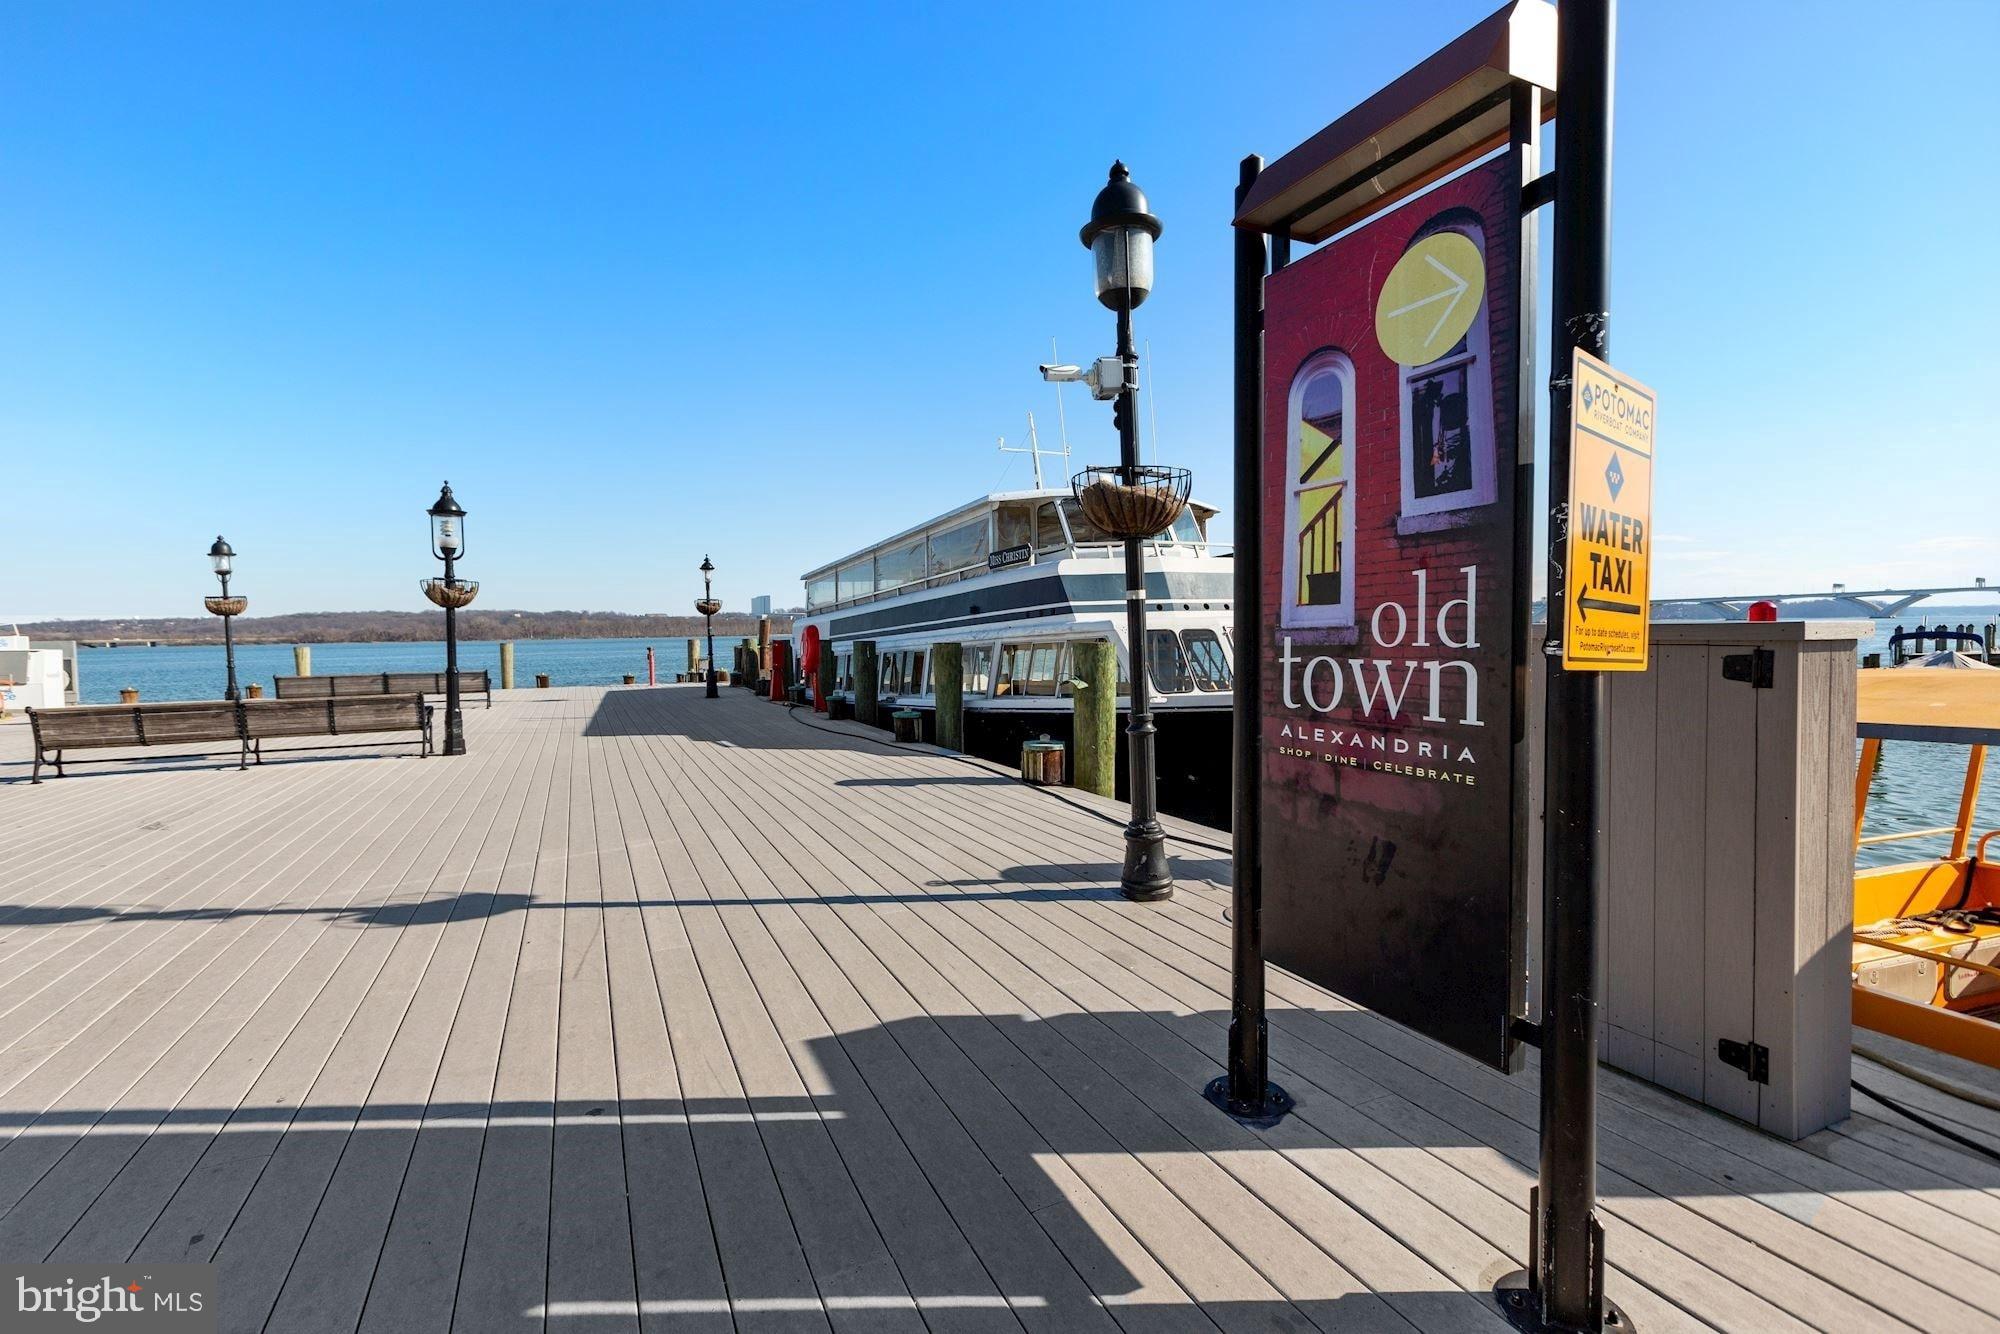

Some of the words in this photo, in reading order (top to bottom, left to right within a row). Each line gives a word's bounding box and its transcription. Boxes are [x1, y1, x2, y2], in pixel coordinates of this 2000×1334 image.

[1594, 384, 1650, 430] POTOMAC
[1594, 409, 1623, 431] RIVERBOAT
[1625, 425, 1649, 440] COMPANY
[1580, 502, 1643, 554] WATER
[1589, 552, 1632, 594] TAXI
[1371, 564, 1481, 649] old
[1575, 625, 1584, 635] For
[1598, 629, 1608, 638] date
[1278, 636, 1485, 727] town
[1281, 724, 1476, 764] ALEXANDRIA
[1279, 746, 1312, 759] SHOP
[1325, 753, 1358, 767] DINE
[1373, 760, 1475, 786] CELEBRATE
